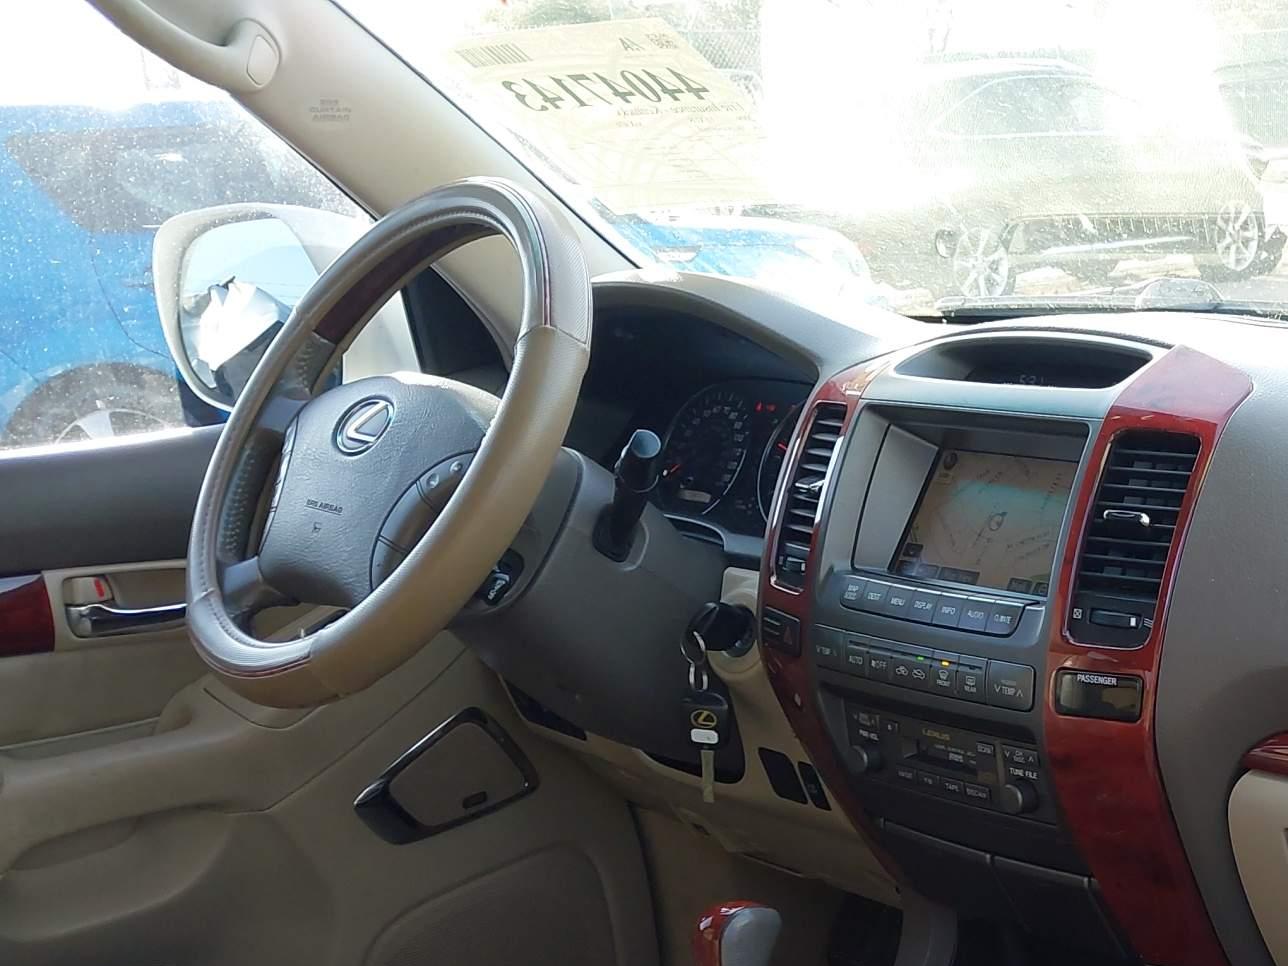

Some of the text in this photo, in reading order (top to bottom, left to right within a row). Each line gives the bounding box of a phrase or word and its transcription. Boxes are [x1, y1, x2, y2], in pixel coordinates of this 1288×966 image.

[318, 502, 344, 514] AIRBAG
[890, 597, 906, 606] MENU
[913, 600, 933, 610] DISPLAY
[941, 605, 956, 615] INFO
[967, 609, 984, 619] AUDIO
[848, 654, 863, 665] AUTO
[1076, 673, 1118, 686] PASSENGER
[1009, 767, 1039, 780] TUNE FILE
